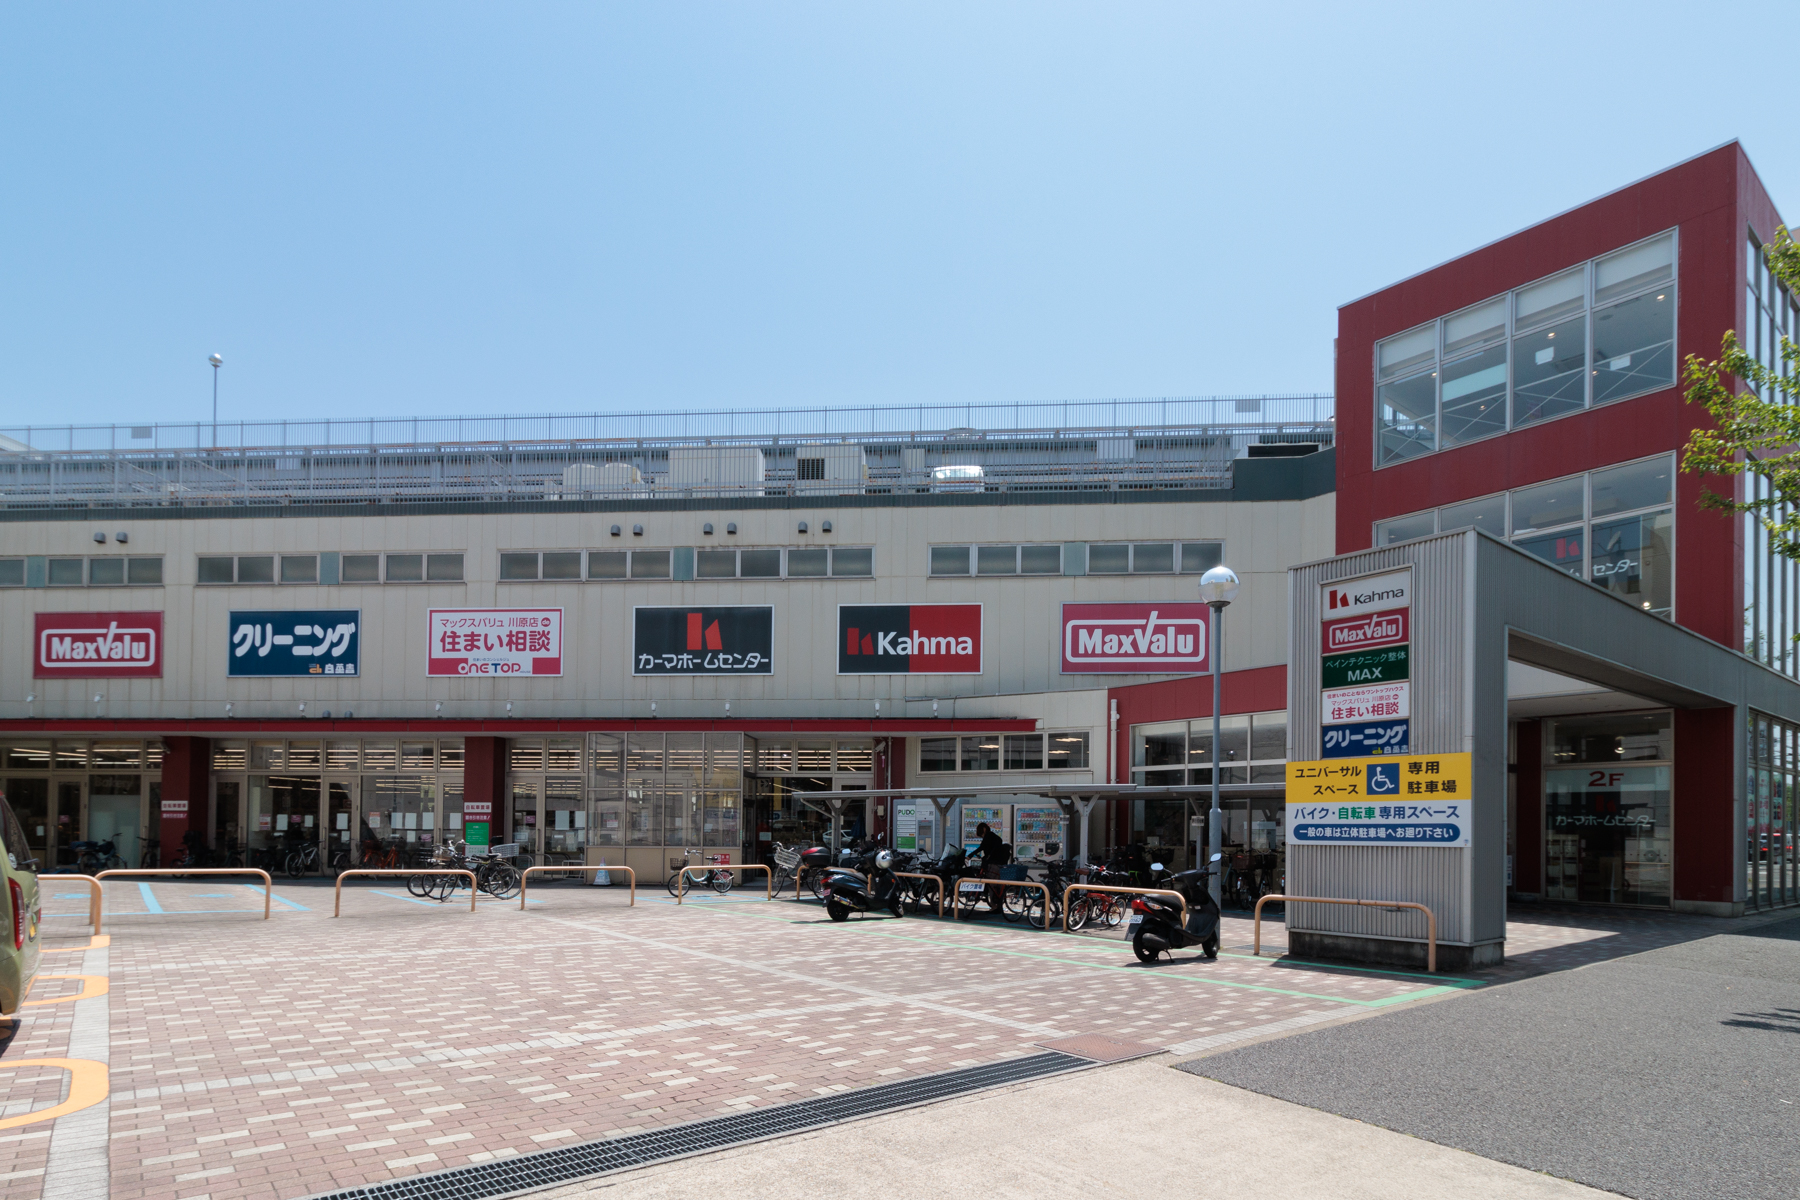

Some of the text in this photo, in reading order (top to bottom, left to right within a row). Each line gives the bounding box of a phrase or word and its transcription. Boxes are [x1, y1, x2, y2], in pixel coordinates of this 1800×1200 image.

[1354, 588, 1404, 604] Kahma
[440, 617, 504, 628] マックスバリュ
[508, 617, 539, 628] 川原店
[1335, 614, 1396, 643] MaxValu
[51, 621, 146, 660] MaxValu
[233, 622, 356, 657] クリーニング
[1078, 611, 1194, 654] MaxValu
[440, 630, 551, 653] 住まい相談
[877, 627, 973, 656] Kahma
[638, 653, 769, 669] カーマホームセンター
[1347, 666, 1382, 682] MAX
[1327, 686, 1404, 699] 住まいのことならワントップハウス
[1331, 696, 1370, 706] マックスバリュ
[1372, 694, 1391, 703] 川原店
[1331, 701, 1399, 720] 住まい相談
[1324, 724, 1407, 748] クリーニング
[1295, 765, 1362, 779] ユニバーサル
[1408, 761, 1440, 775] 専用
[1407, 780, 1457, 794] 駐車場
[1588, 771, 1624, 787] 2F
[1313, 784, 1359, 796] スペース
[1555, 815, 1656, 827] カーマホームセンター
[1299, 827, 1453, 839] 一般の車は立体駐車場へお廻り下さい
